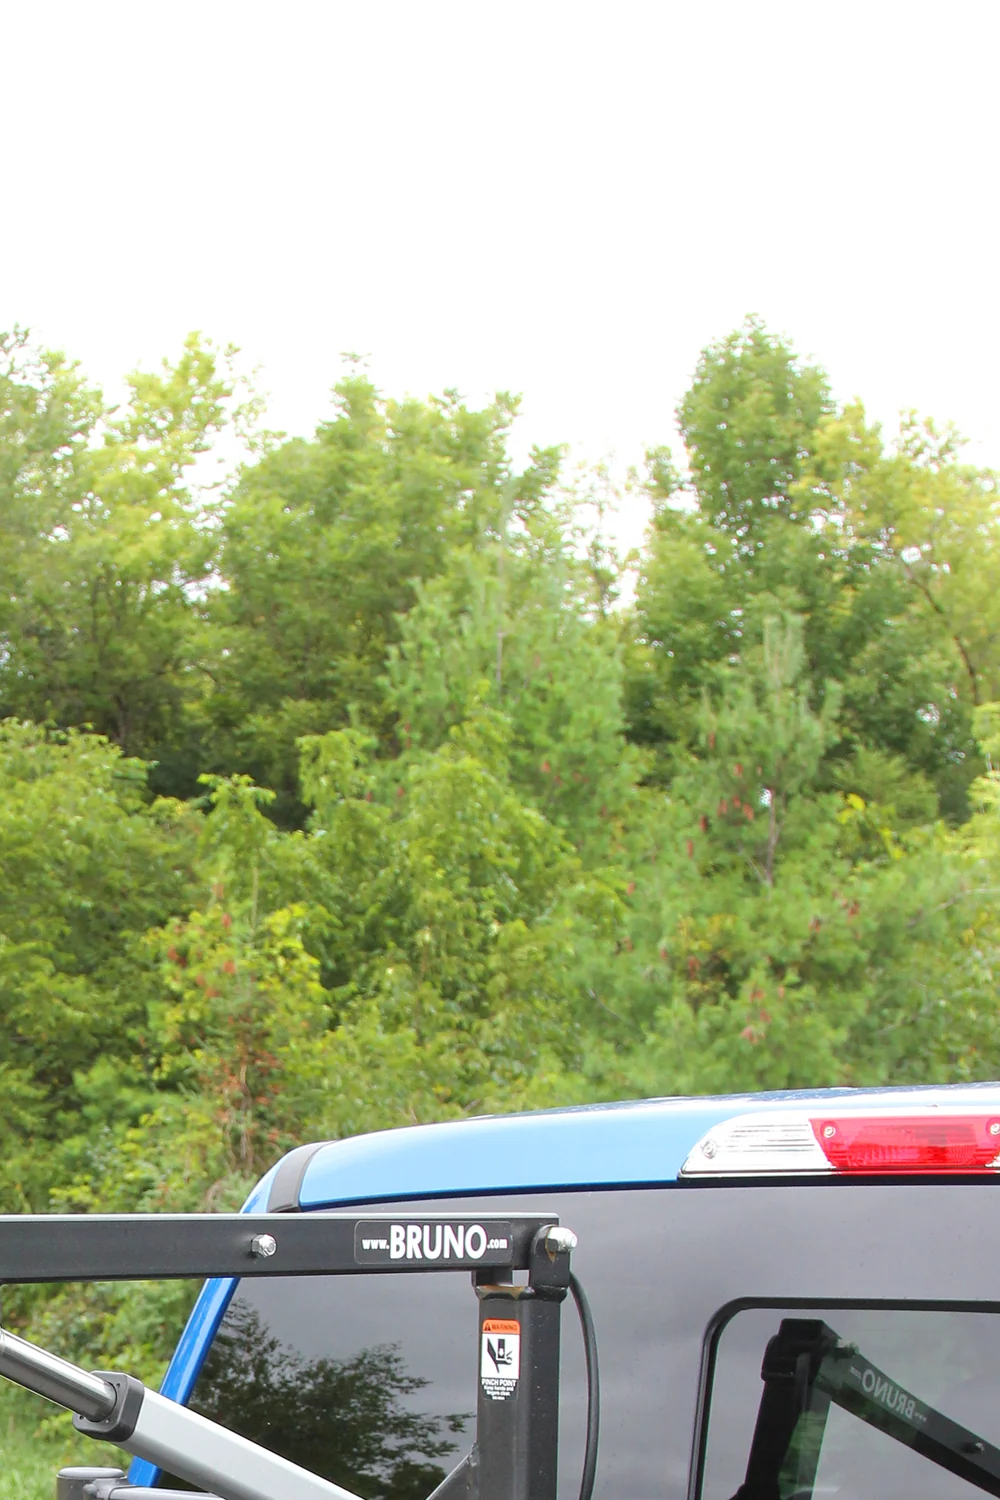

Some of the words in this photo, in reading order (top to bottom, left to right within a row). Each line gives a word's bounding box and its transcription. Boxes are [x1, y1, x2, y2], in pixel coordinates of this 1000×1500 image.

[361, 1224, 508, 1260] www.BRUNO.com
[491, 1323, 518, 1331] WARNING
[481, 1378, 499, 1386] PINCH
[500, 1379, 516, 1387] POINT
